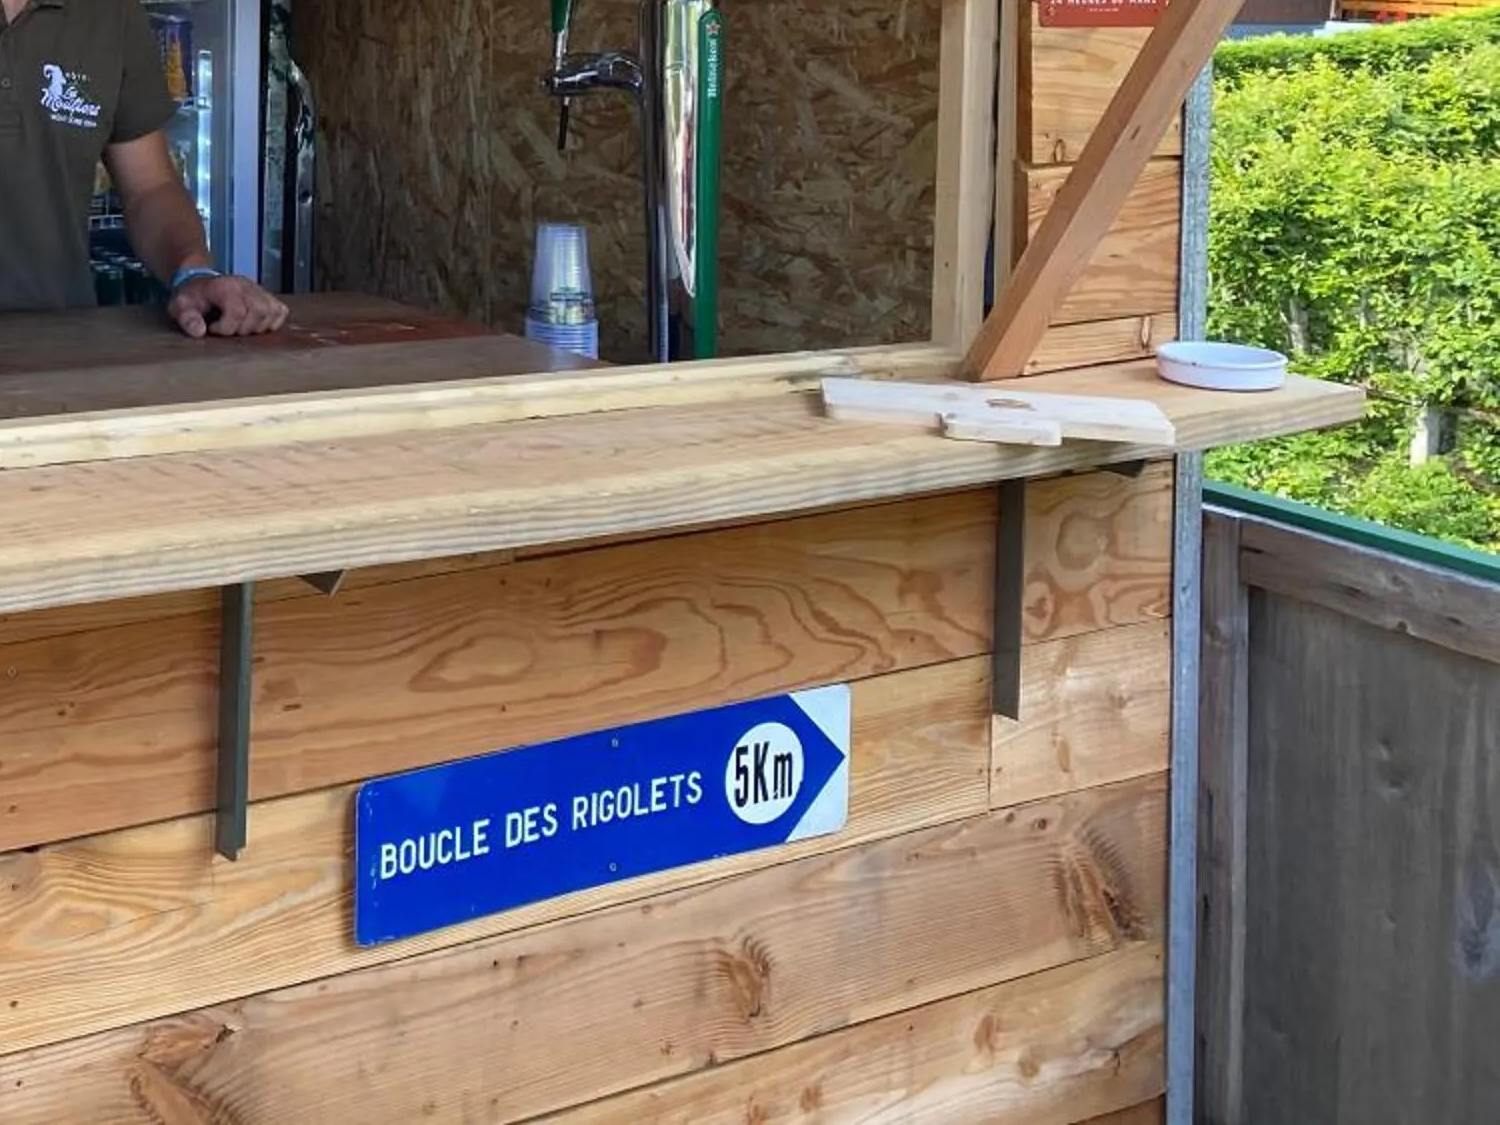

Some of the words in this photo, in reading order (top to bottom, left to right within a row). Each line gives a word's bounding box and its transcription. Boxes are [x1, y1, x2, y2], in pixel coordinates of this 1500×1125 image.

[381, 818, 491, 880] BOUCLE
[505, 803, 558, 849] DES
[572, 771, 703, 832] RIGOLETS
[733, 741, 794, 808] 5Km
